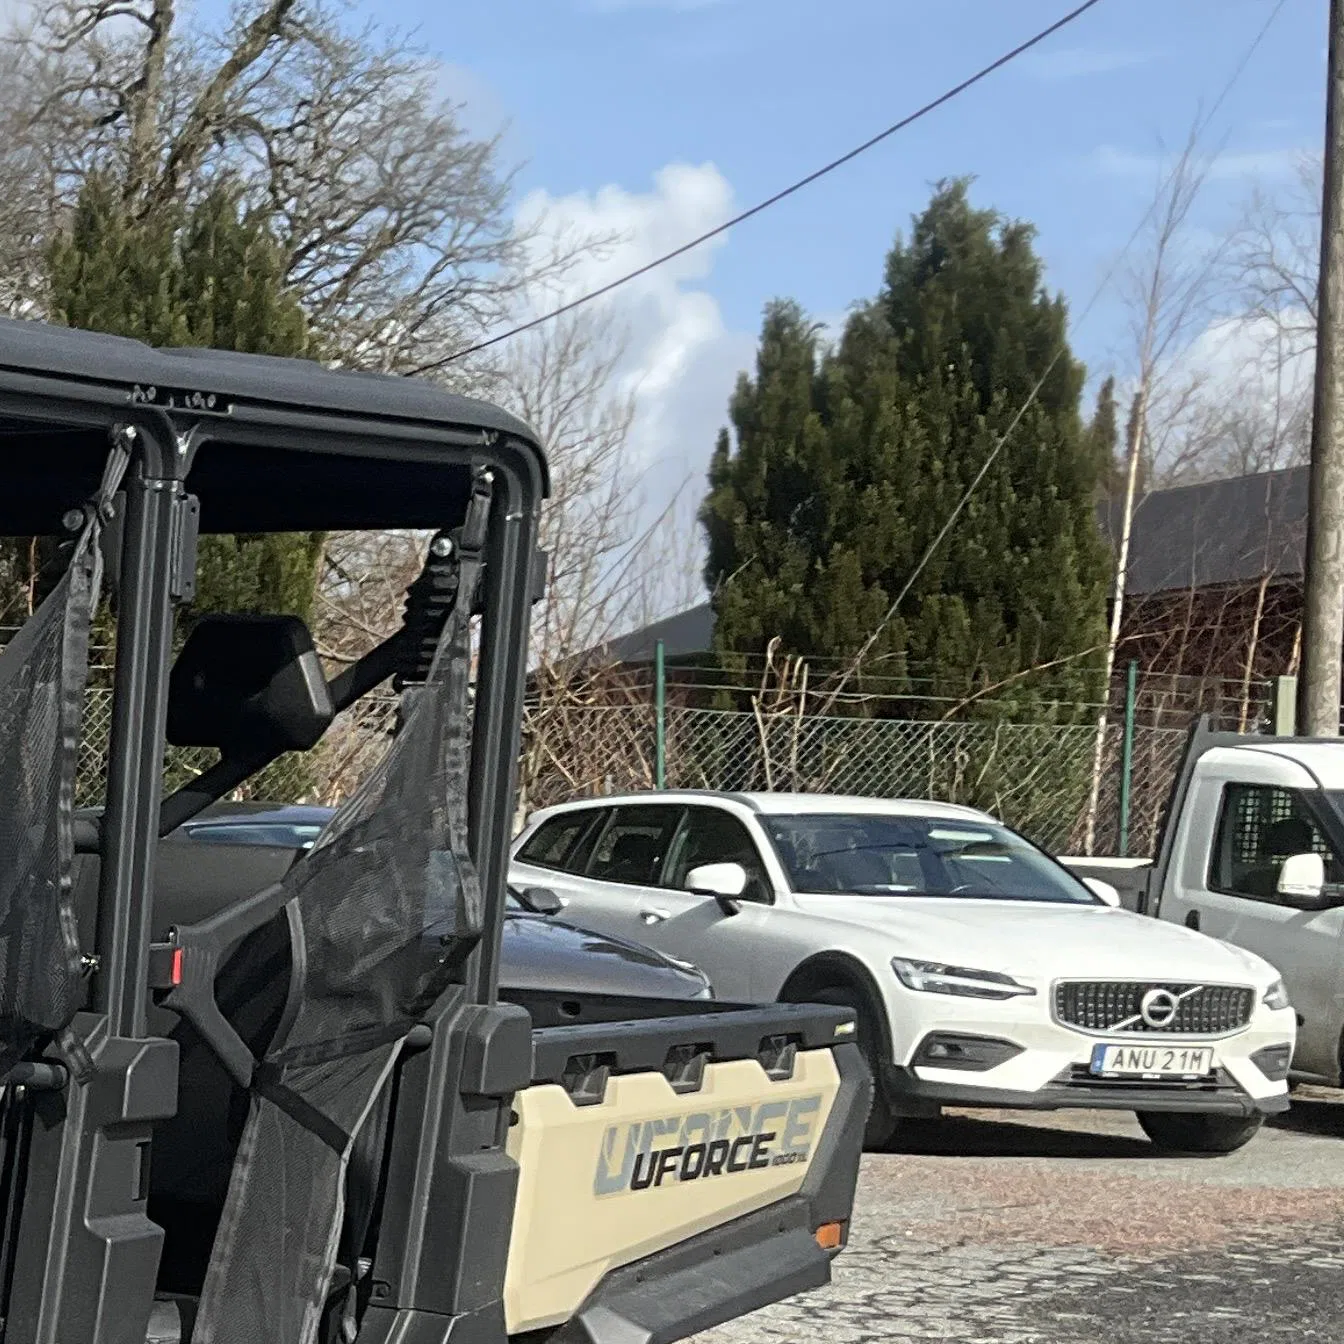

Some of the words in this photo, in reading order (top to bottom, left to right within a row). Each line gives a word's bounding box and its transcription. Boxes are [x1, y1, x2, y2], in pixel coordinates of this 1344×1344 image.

[1112, 1049, 1156, 1070] ANU
[1161, 1050, 1204, 1071] 21M
[630, 1132, 776, 1191] UFORCE
